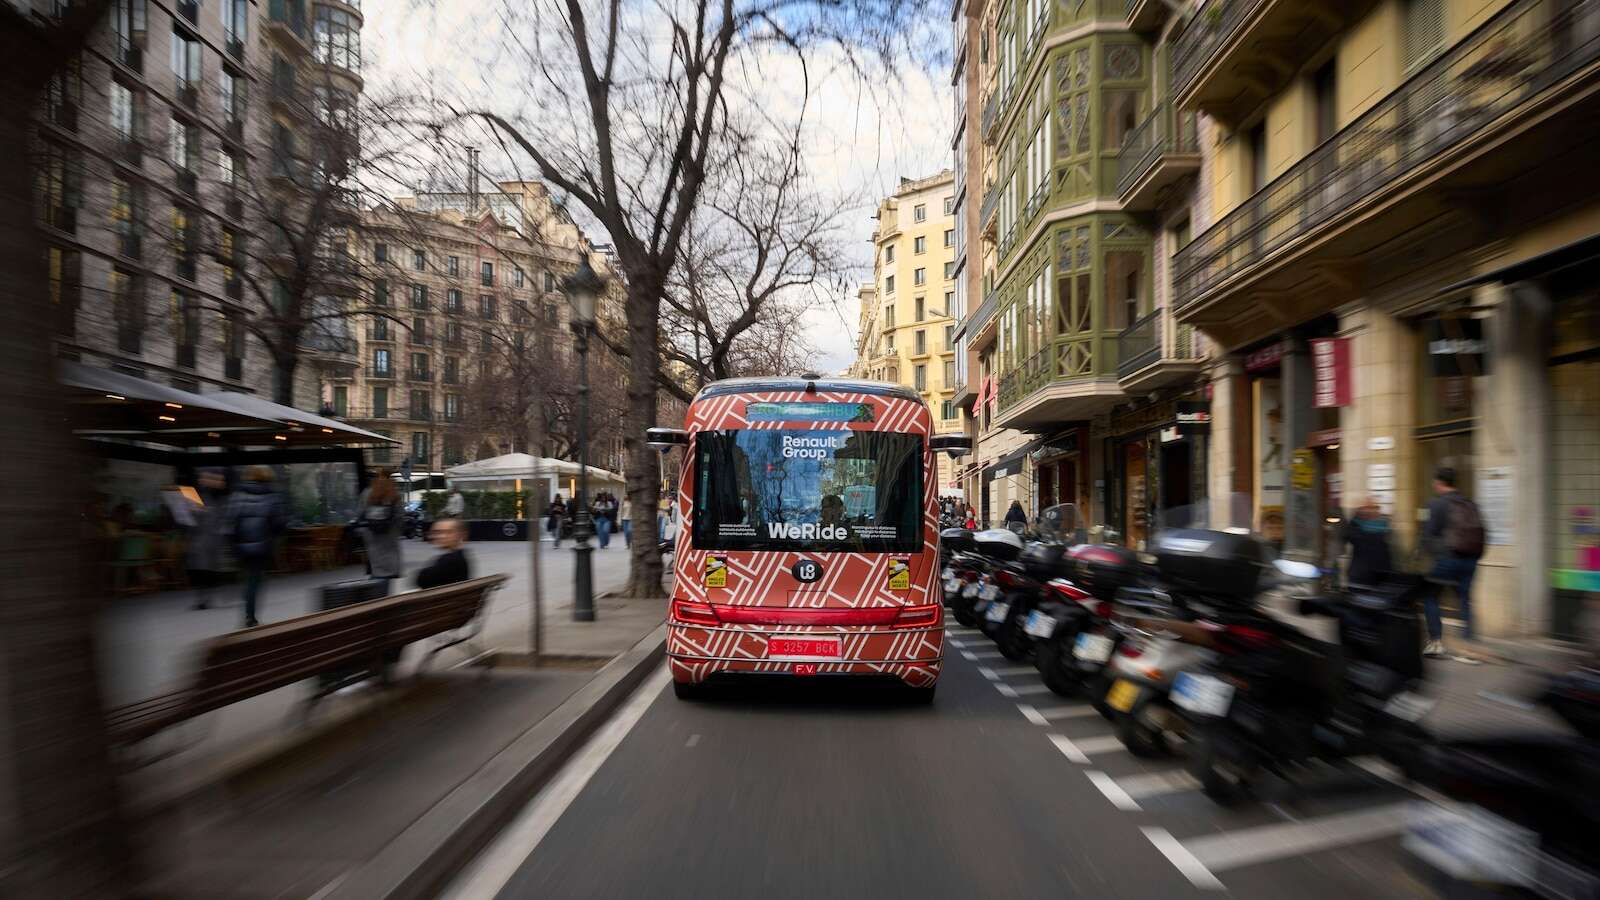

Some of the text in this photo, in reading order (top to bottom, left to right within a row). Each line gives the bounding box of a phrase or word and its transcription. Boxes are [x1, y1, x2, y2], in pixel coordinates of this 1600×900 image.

[783, 436, 837, 447] Renault
[783, 448, 827, 460] Group
[768, 522, 848, 540] WeRide
[771, 642, 835, 654] S 3257 BCK
